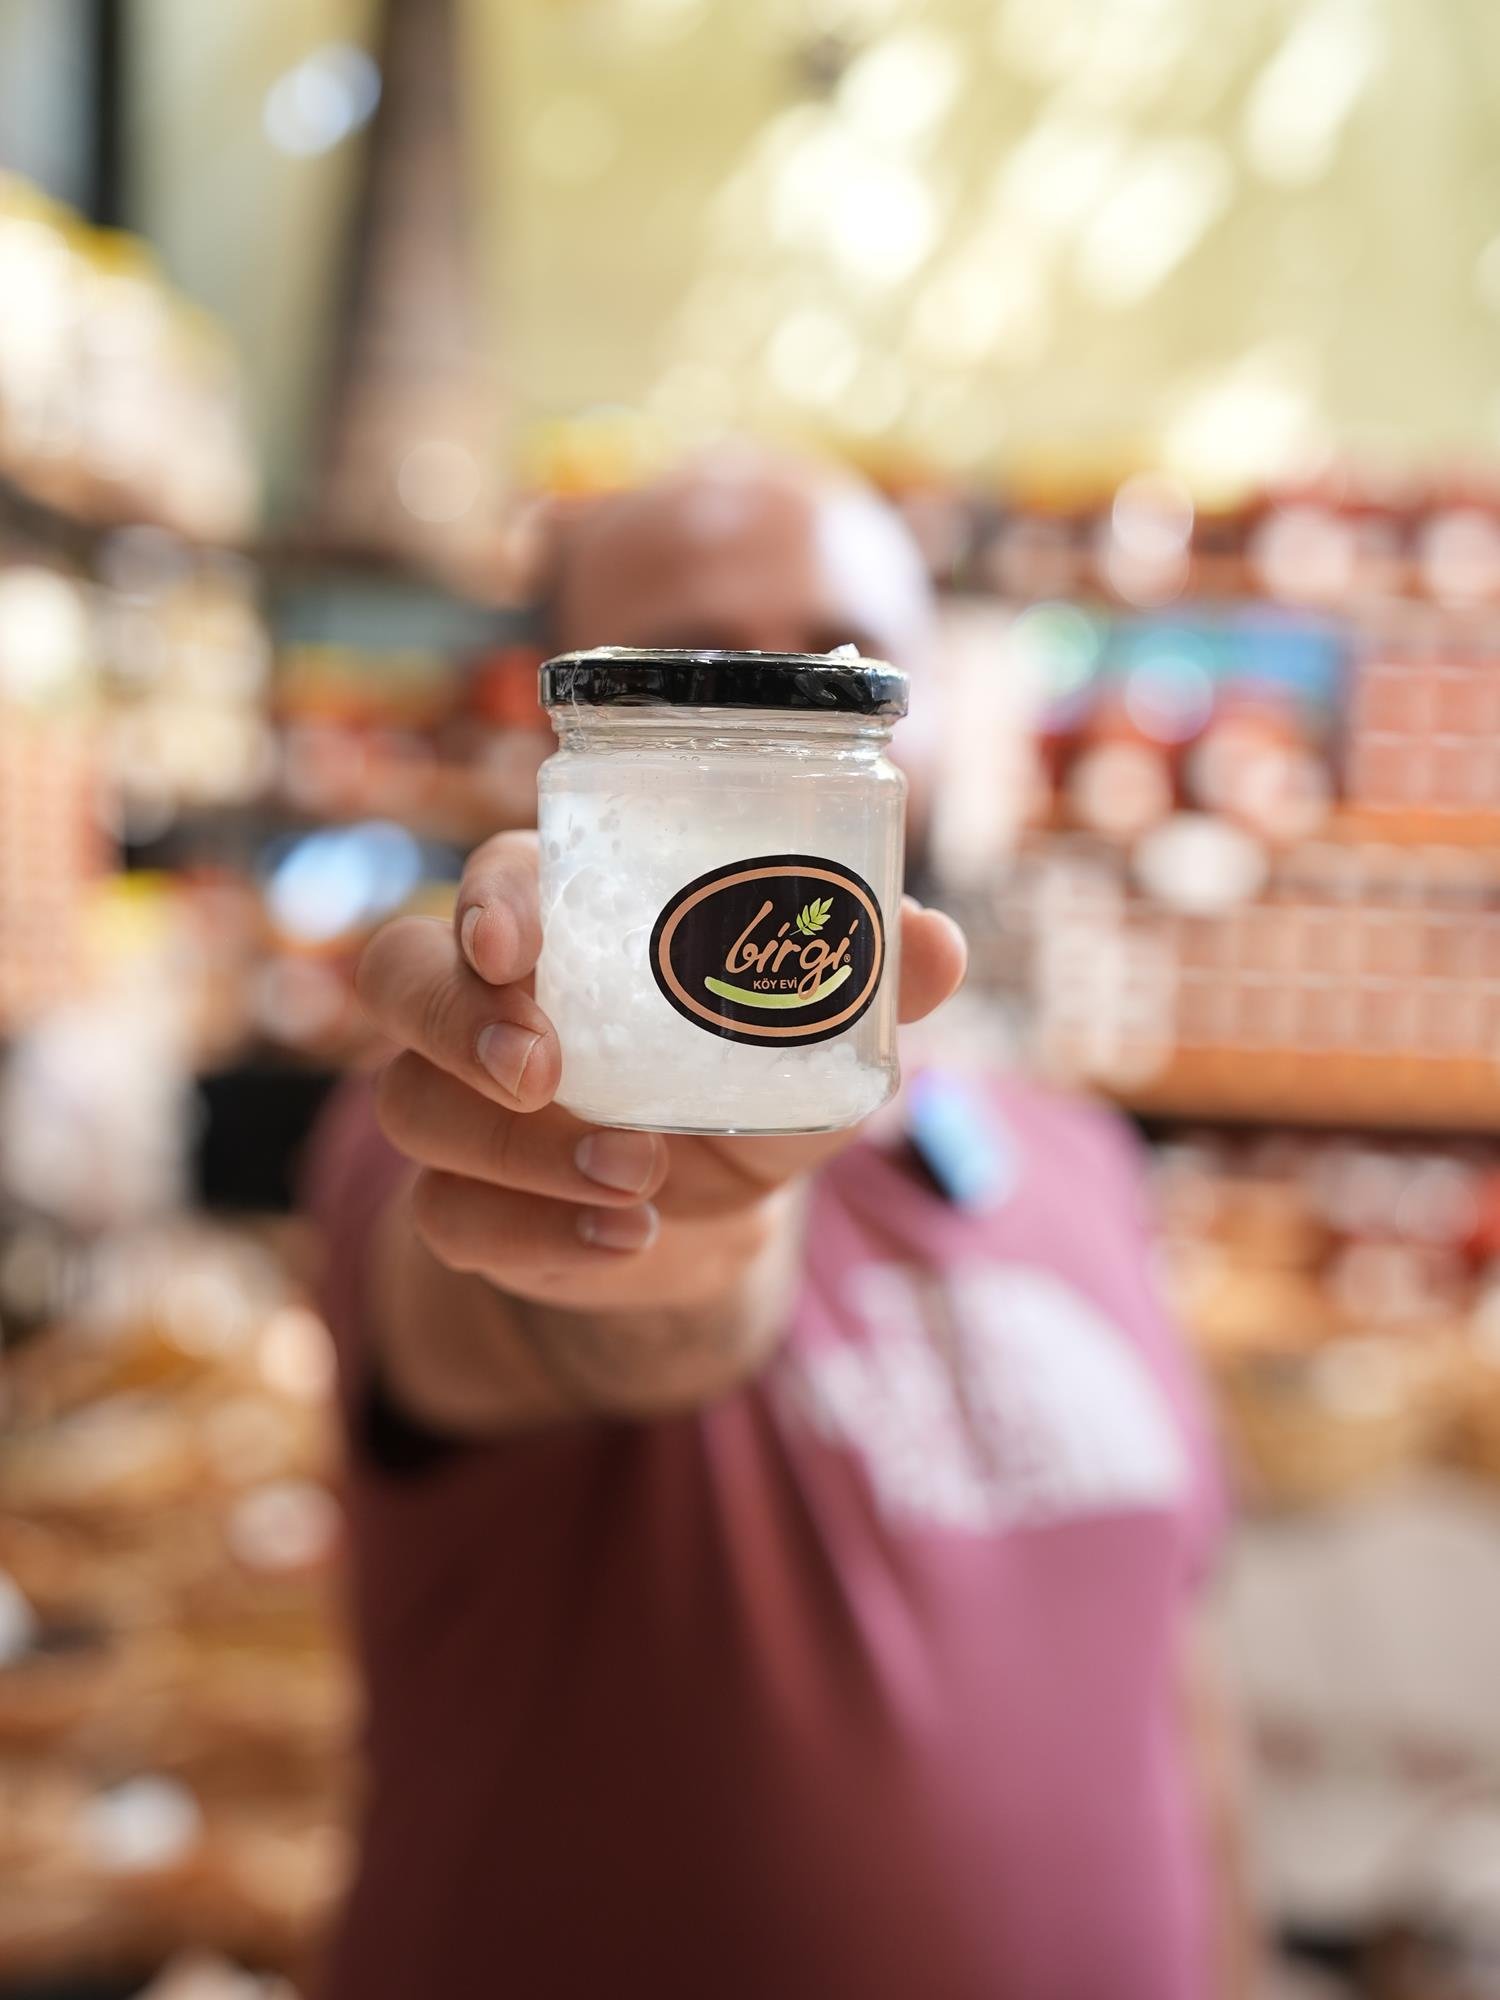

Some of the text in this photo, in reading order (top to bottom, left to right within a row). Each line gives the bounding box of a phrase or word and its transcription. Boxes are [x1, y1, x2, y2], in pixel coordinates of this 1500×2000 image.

[725, 900, 859, 1000] birgi
[753, 976, 798, 990] KÖY EVİ
